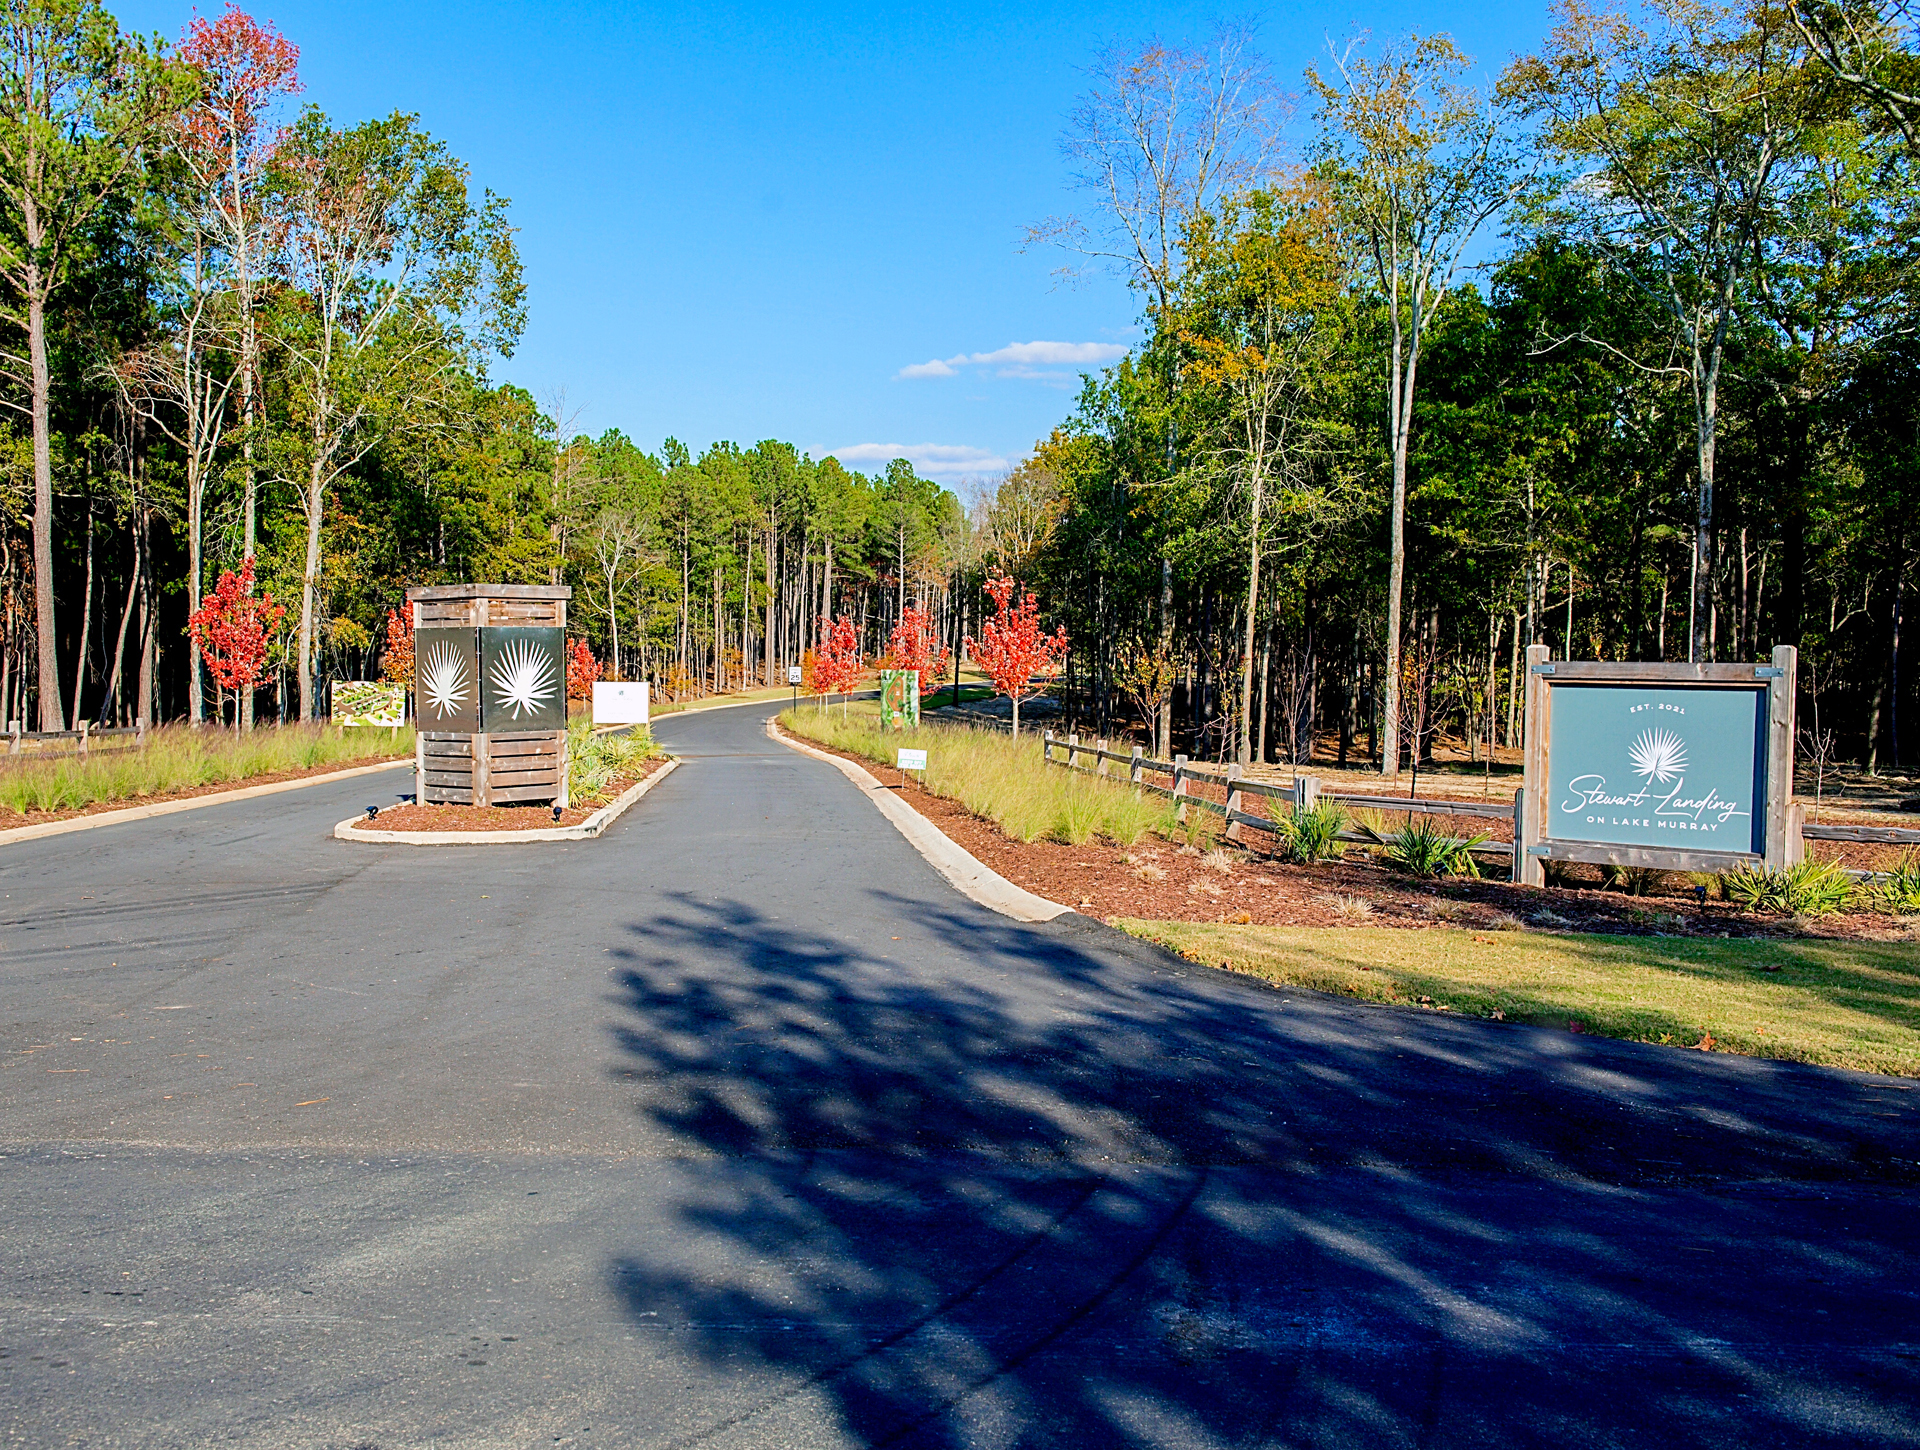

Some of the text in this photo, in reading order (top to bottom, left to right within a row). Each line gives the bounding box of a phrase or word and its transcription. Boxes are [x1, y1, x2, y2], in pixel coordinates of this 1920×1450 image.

[1629, 703, 1685, 715] EST. 2021
[1561, 774, 1751, 823] Stewart Landing
[1586, 815, 1719, 832] ON LAKE MURRAY
